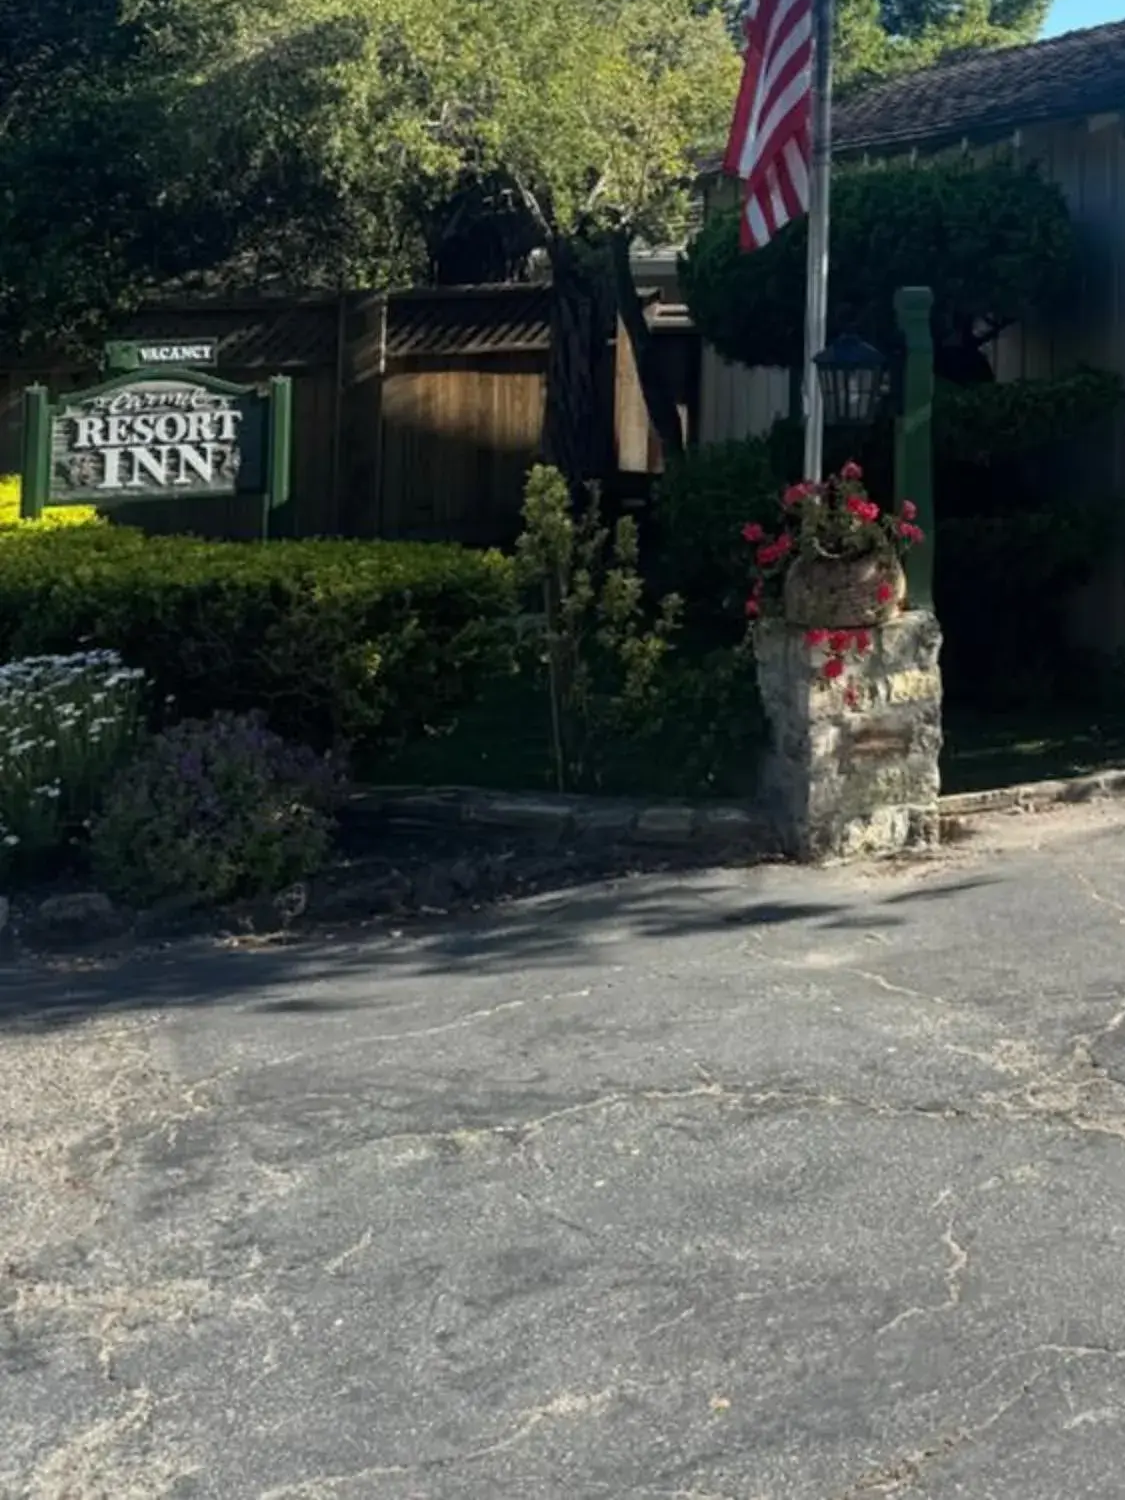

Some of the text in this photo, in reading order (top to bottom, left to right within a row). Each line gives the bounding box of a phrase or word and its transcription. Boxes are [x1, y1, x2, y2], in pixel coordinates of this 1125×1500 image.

[140, 345, 211, 361] VACANCY
[73, 410, 243, 448] RESORT
[97, 442, 222, 488] INN
